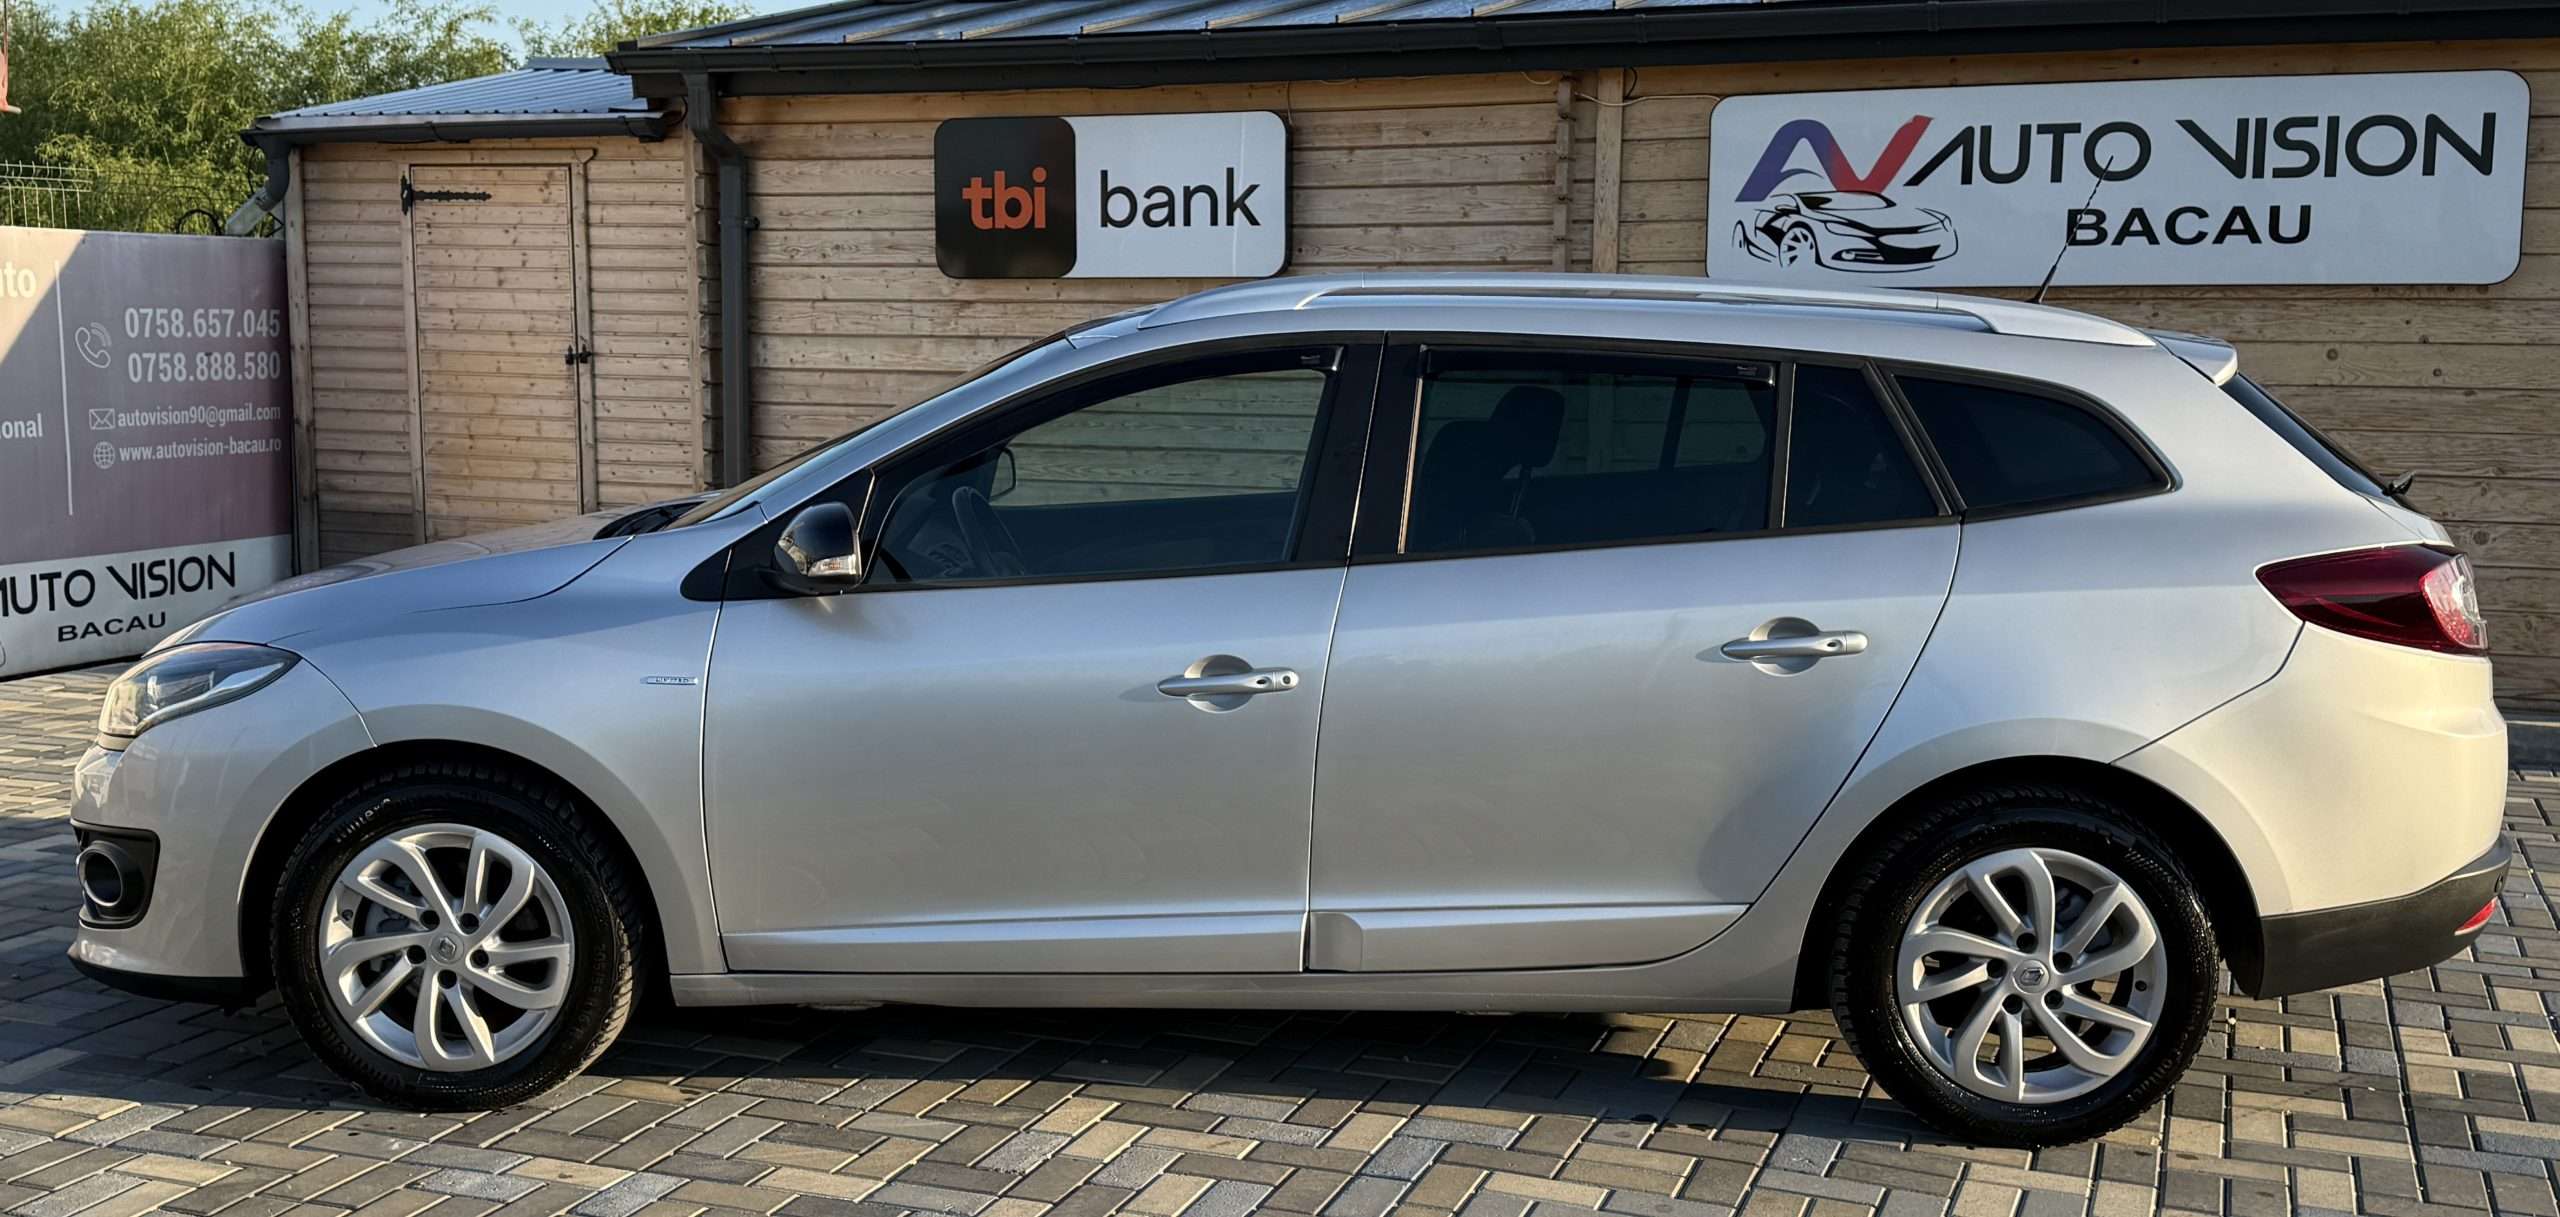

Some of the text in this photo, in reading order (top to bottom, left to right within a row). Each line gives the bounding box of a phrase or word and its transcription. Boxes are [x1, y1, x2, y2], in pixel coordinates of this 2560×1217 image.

[1904, 112, 2496, 187] AUTO VISION
[962, 167, 1261, 230] tbi bank
[2066, 205, 2312, 247] BACAU
[0, 261, 36, 298] to
[124, 307, 280, 338] 0758.657.045
[128, 351, 280, 383] 0758.888.580
[0, 412, 43, 439] onal
[118, 403, 281, 428] autovision90@gmail.com
[119, 436, 282, 461] www.autovision-bacau.ro
[106, 551, 236, 600] VISION
[58, 612, 166, 642] BACAU
